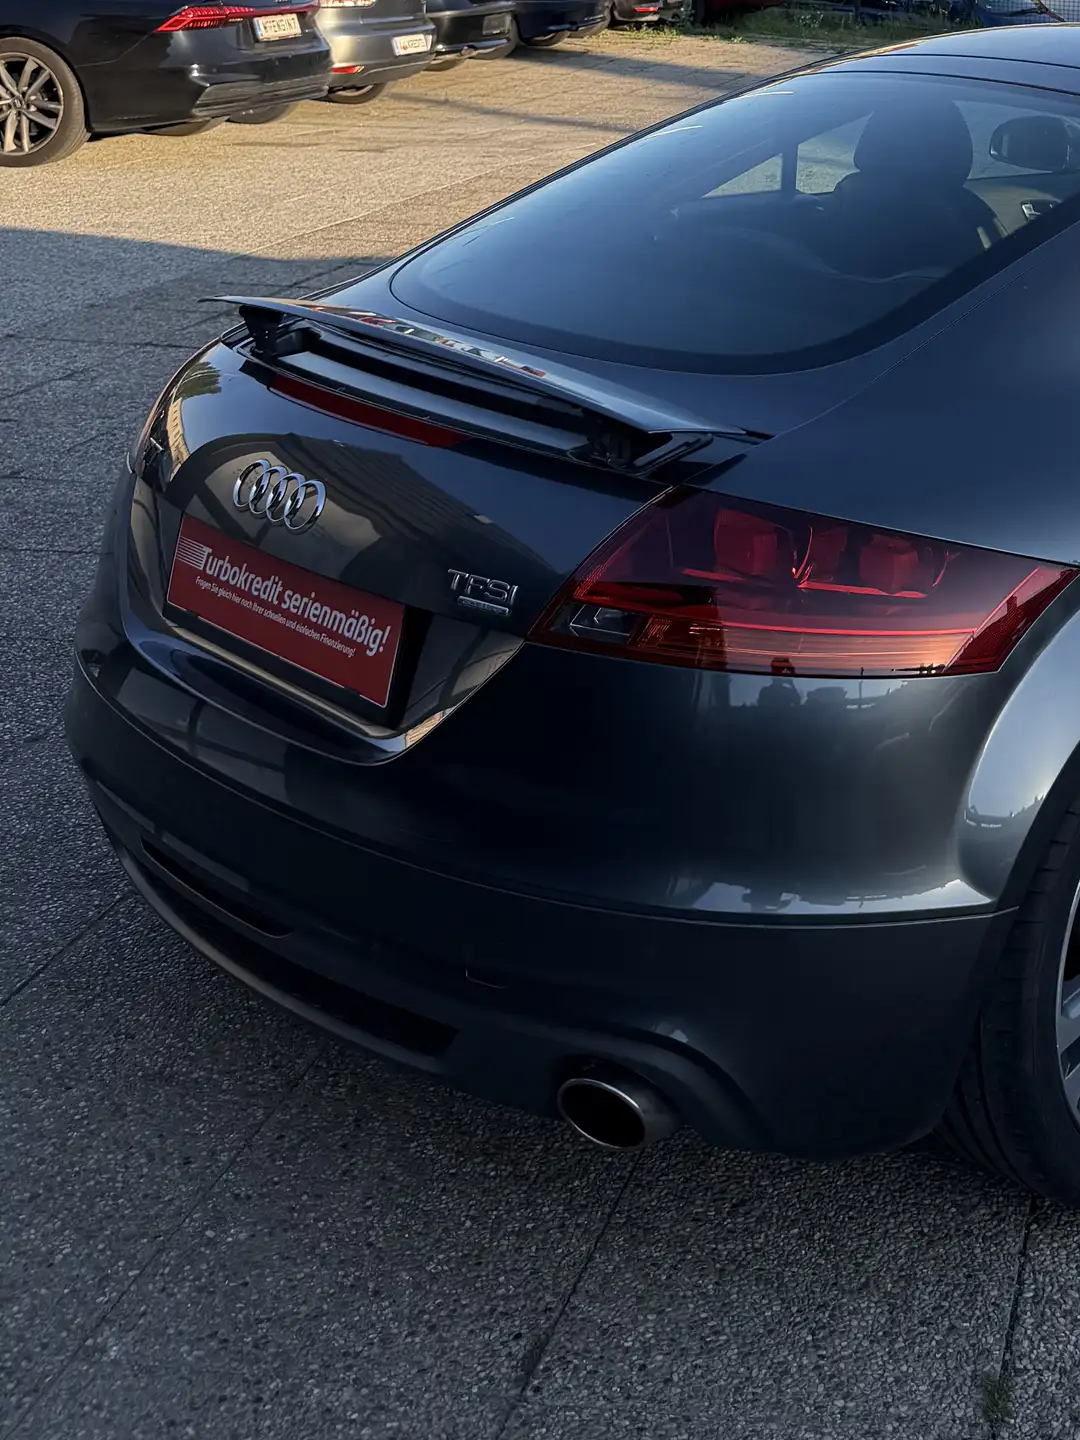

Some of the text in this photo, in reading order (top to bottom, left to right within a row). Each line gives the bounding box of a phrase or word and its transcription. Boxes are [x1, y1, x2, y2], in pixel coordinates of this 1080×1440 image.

[201, 546, 391, 656] Turbokredit serienmäßig!
[447, 568, 519, 605] TFSI
